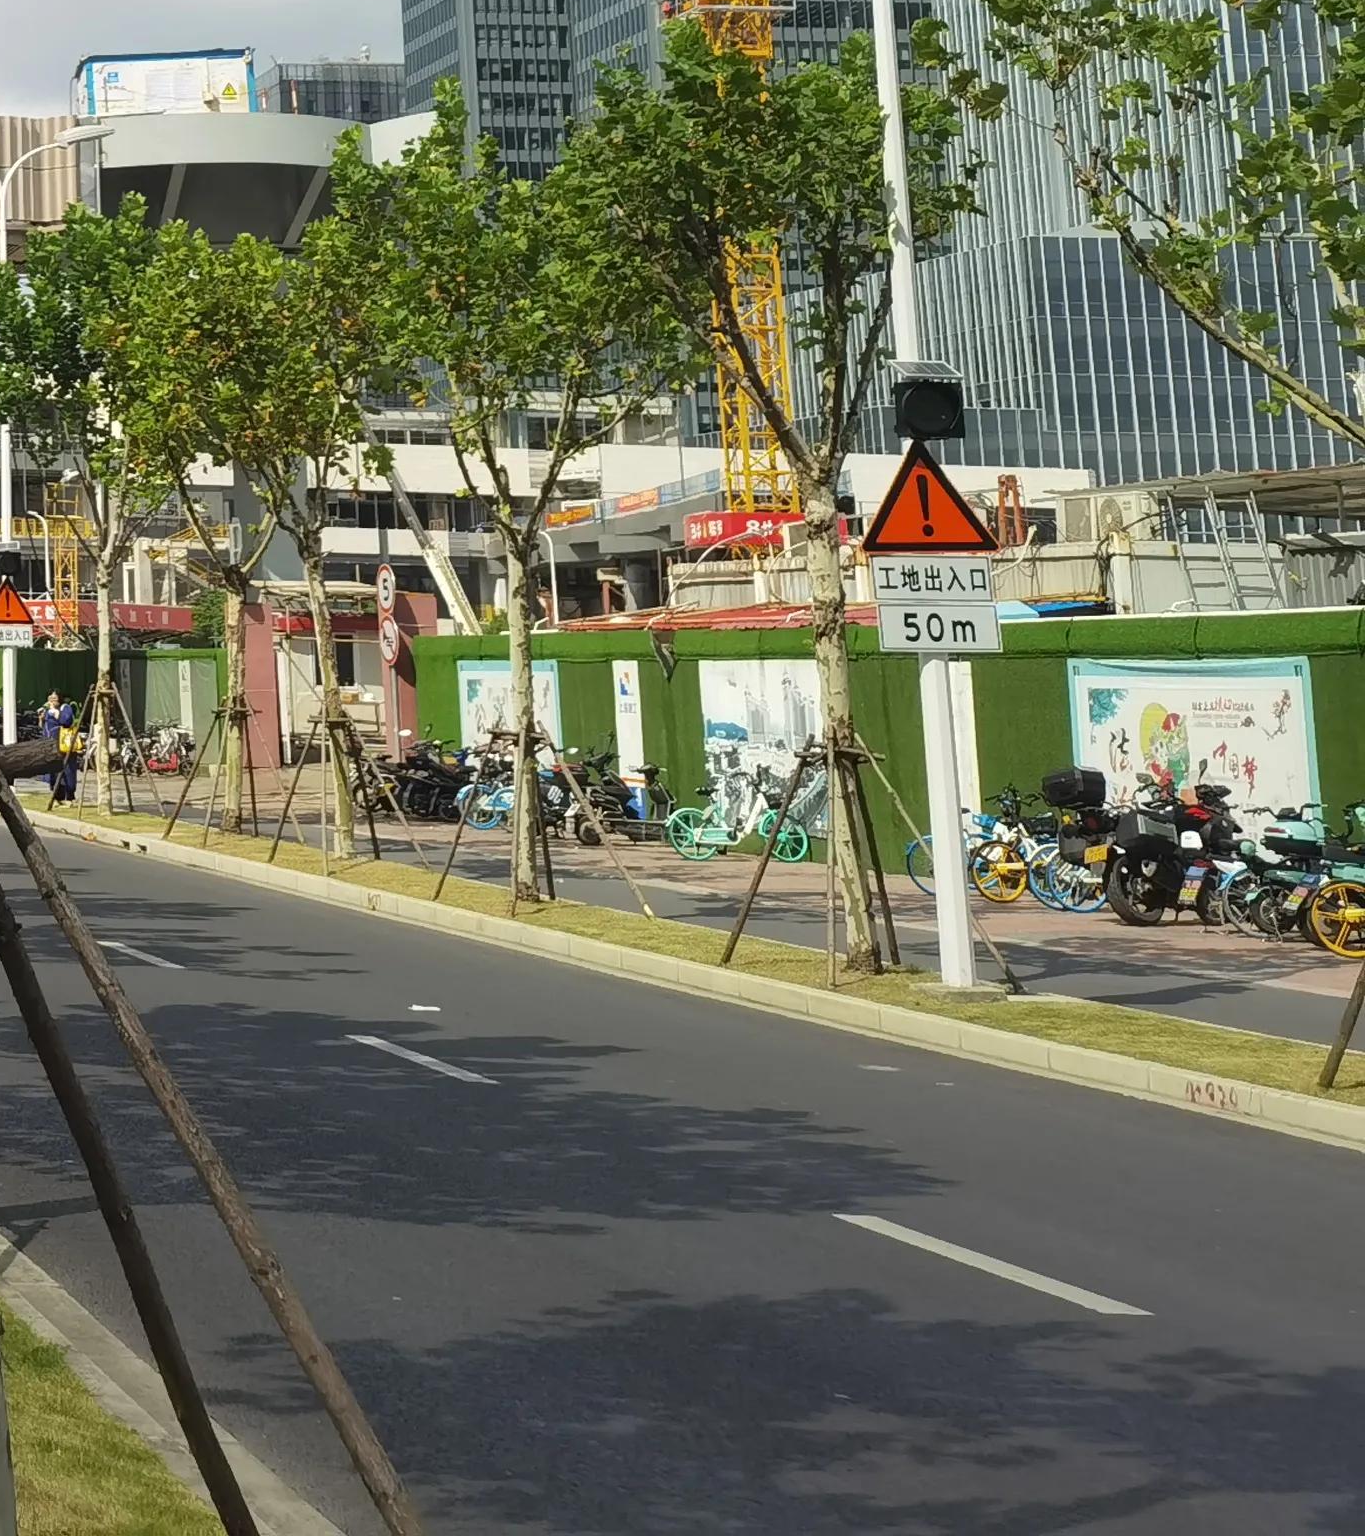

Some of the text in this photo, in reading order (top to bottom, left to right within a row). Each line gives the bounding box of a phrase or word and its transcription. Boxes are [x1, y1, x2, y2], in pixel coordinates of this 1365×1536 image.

[878, 564, 987, 593] 工地出入口
[903, 612, 977, 643] 50m
